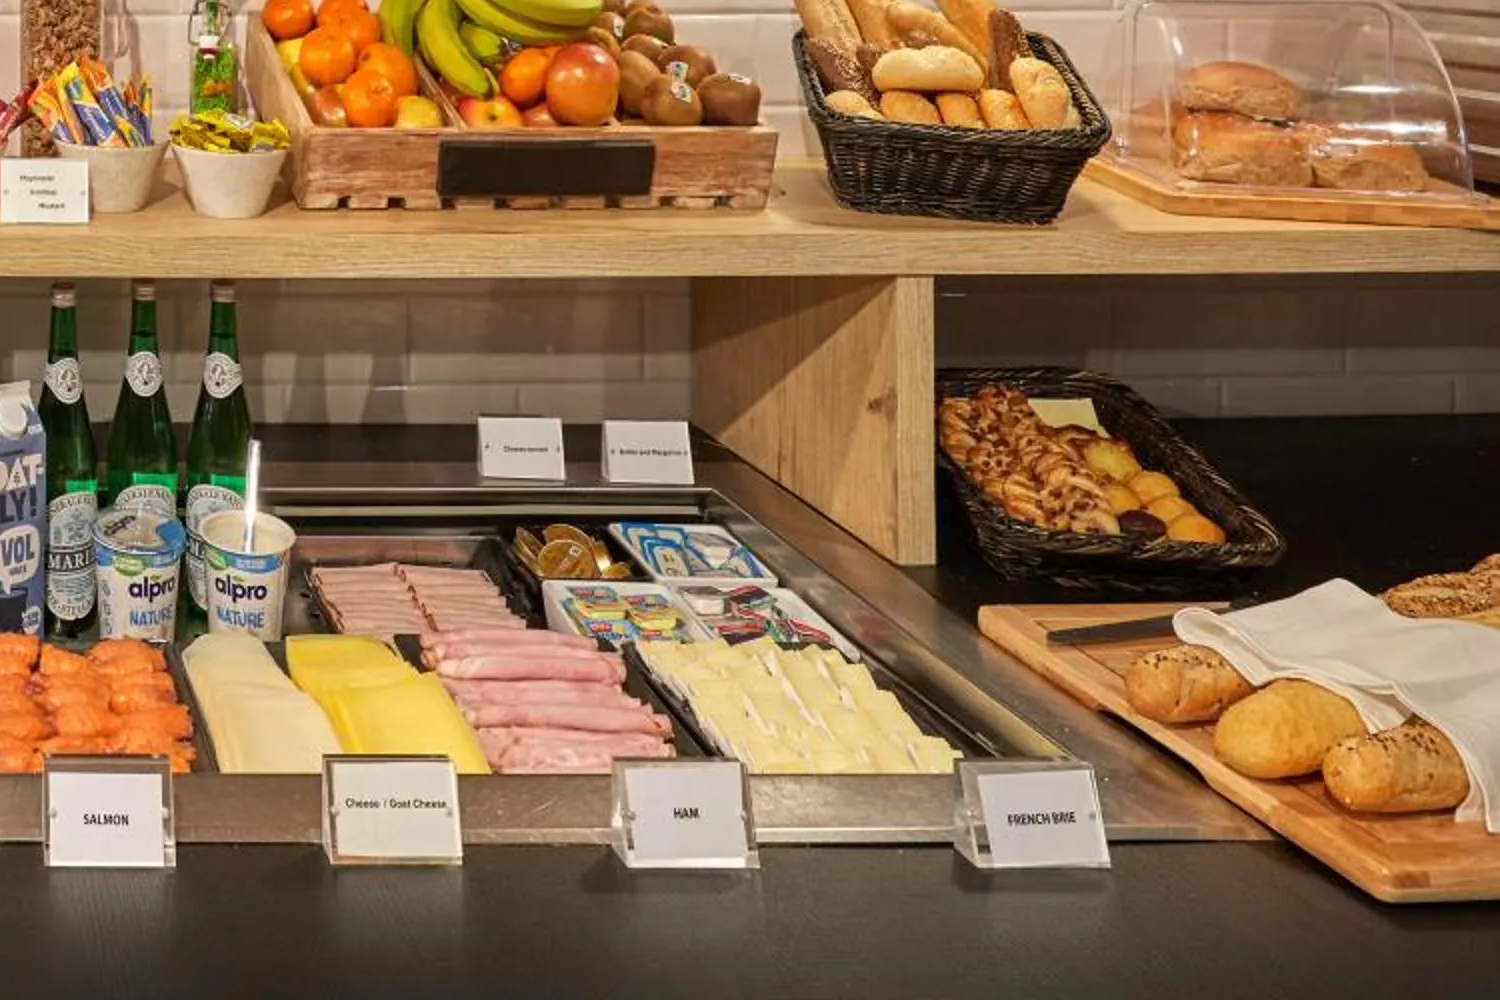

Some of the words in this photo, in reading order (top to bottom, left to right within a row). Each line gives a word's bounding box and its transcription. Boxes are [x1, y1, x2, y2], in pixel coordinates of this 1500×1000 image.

[0, 487, 37, 523] LY!
[0, 533, 36, 567] VOL
[128, 576, 176, 602] alpro
[215, 574, 268, 603] alpro
[129, 604, 173, 627] NATURE
[216, 605, 265, 628] NATURE
[345, 797, 380, 809] Cheese
[389, 798, 411, 809] Goat
[413, 799, 447, 809] Cheese
[673, 807, 699, 819] HAM
[83, 813, 129, 826] SALMON
[1007, 811, 1050, 826] FRENCH
[1051, 811, 1076, 825] BRIE
